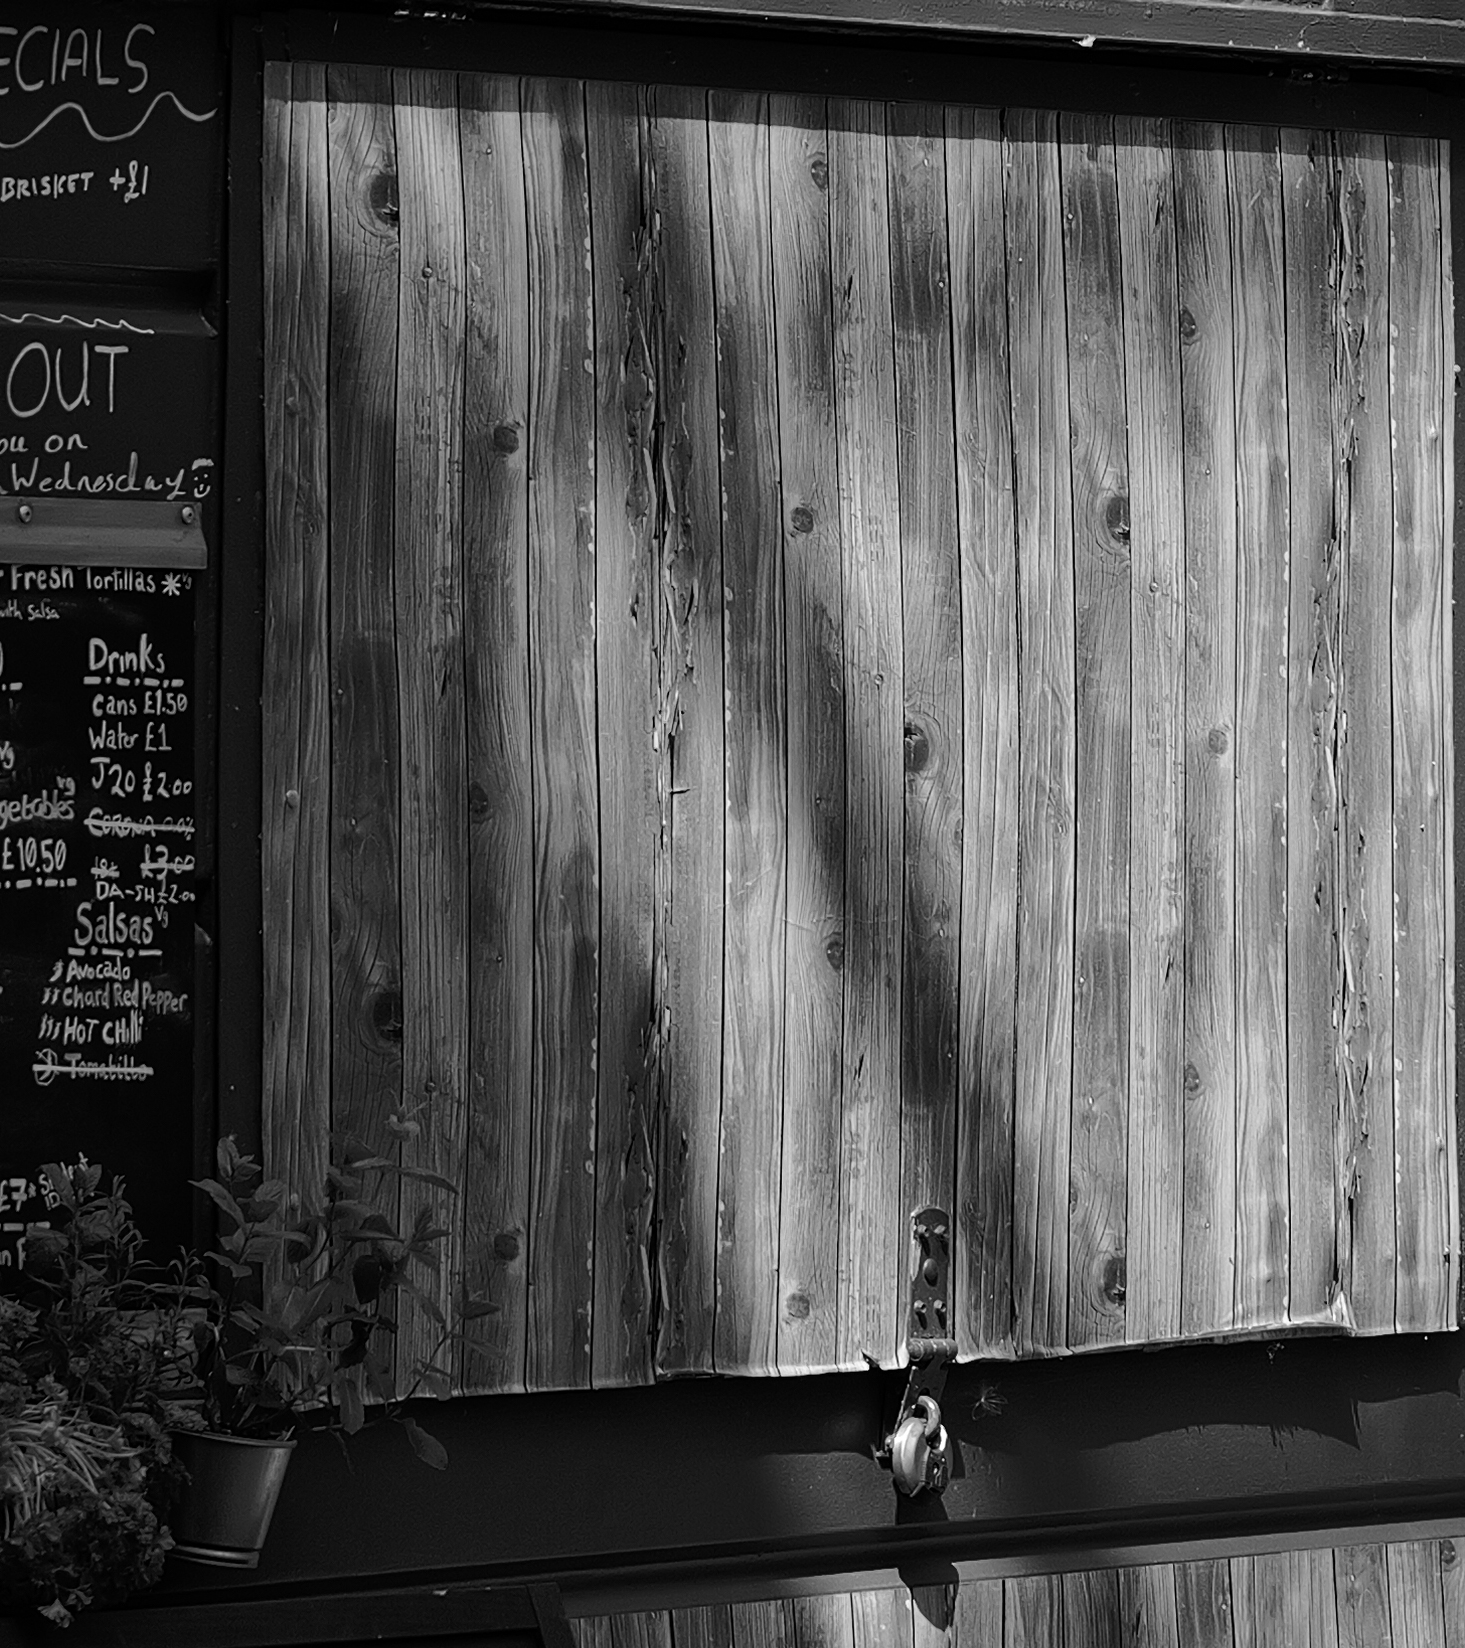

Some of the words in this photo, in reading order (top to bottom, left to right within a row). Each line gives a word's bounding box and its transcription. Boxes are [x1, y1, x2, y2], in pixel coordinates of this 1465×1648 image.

[0, 171, 95, 203] BRISKET
[6, 339, 130, 414] OUT
[11, 450, 186, 501] Wednesday
[11, 564, 75, 590] Fresh
[83, 566, 156, 593] Tortillas
[27, 599, 60, 621] Salsa
[88, 633, 165, 674] Drinks
[143, 690, 188, 716] £1.50
[87, 720, 139, 751] Water
[144, 721, 172, 752] £1
[2, 836, 67, 873] £10.50
[75, 901, 154, 946] Salsas
[66, 956, 131, 983] Avocado
[112, 978, 139, 1007] Red
[142, 980, 188, 1015] Pepper
